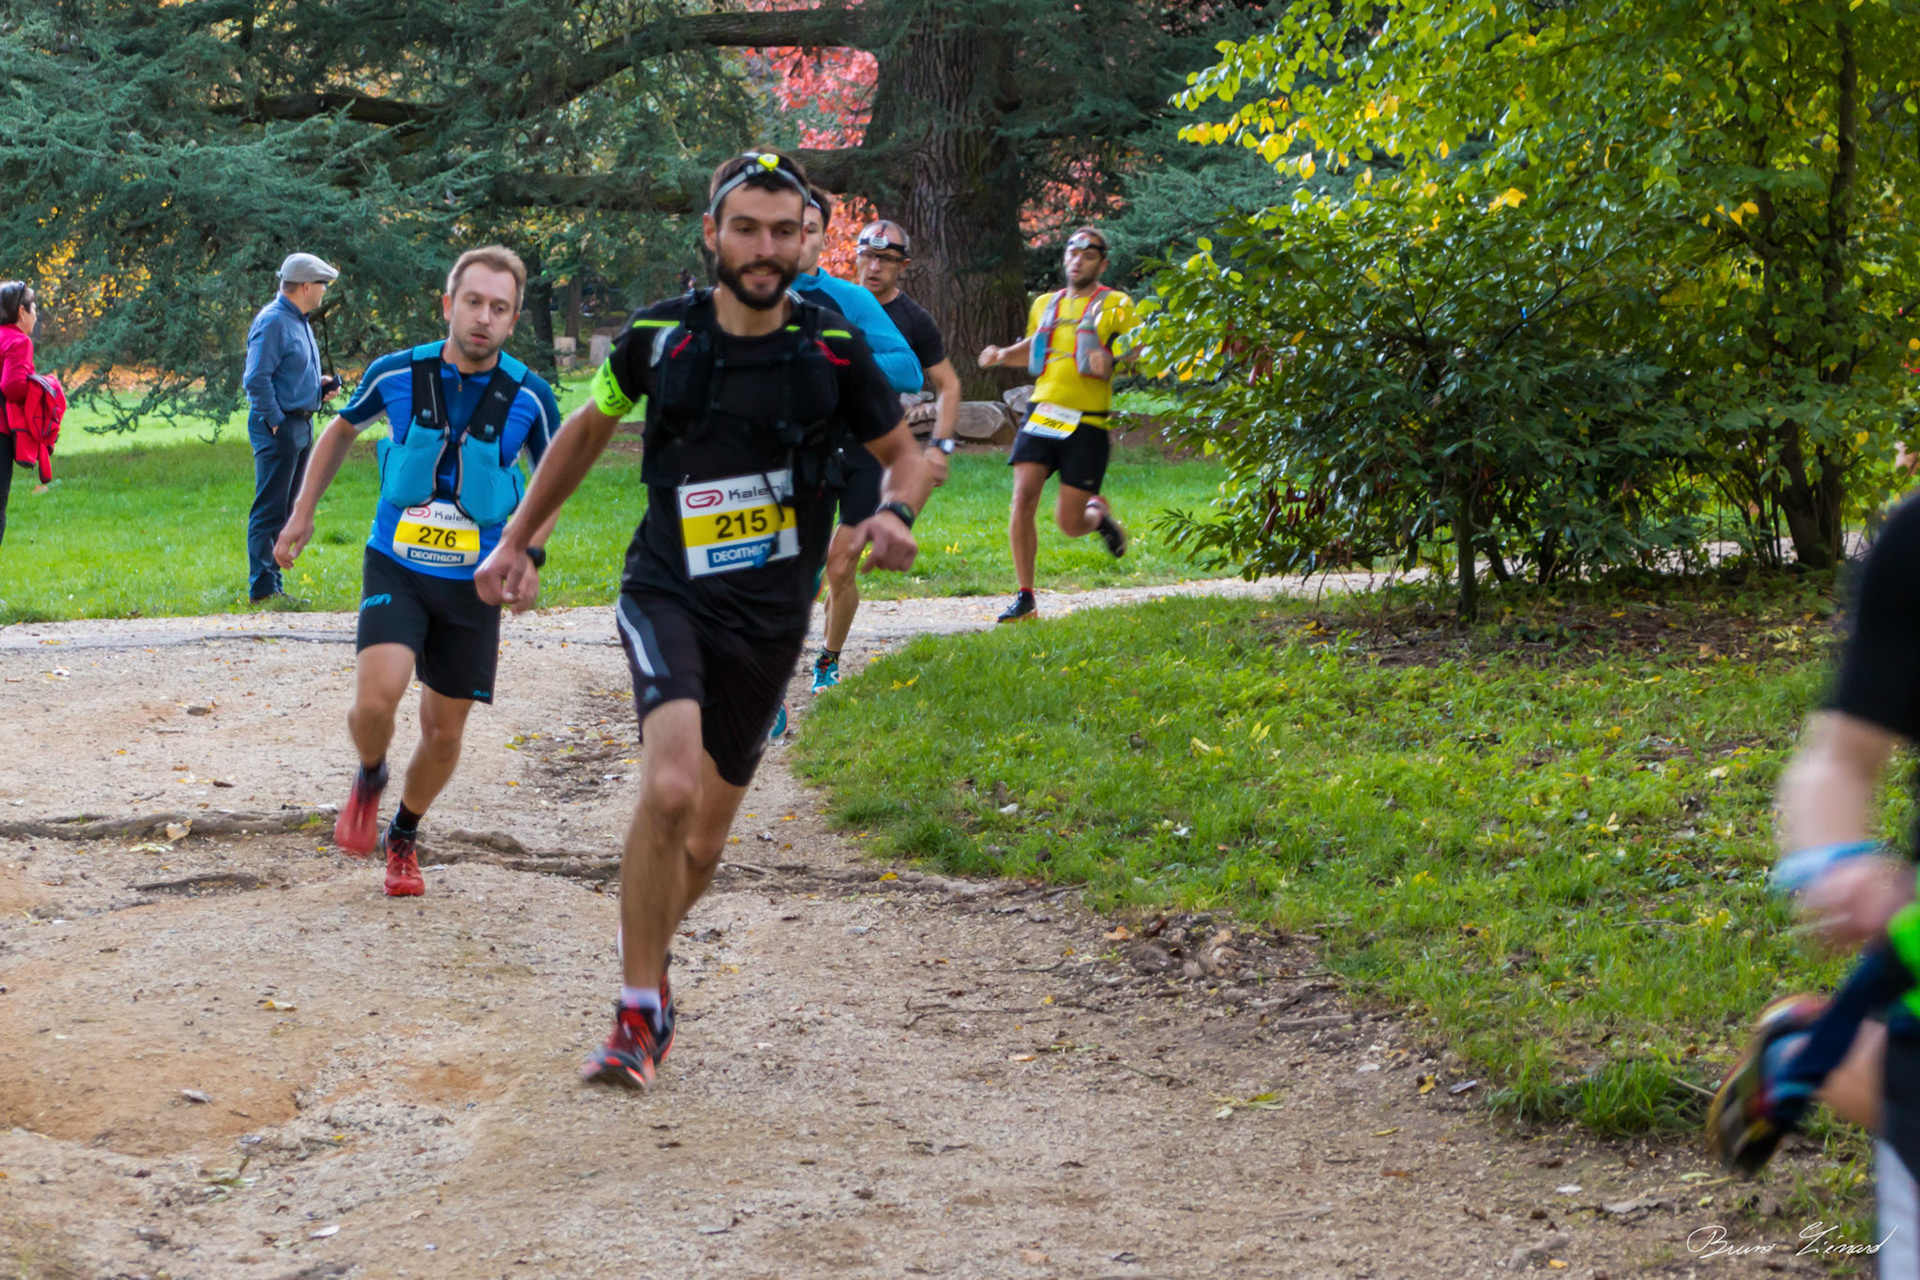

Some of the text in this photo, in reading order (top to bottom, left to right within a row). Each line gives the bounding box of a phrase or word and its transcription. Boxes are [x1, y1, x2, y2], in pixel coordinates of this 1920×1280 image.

[715, 509, 768, 539] 215
[418, 526, 457, 548] 276
[410, 549, 461, 562] DECATHLON
[712, 542, 771, 563] DECATHLO
